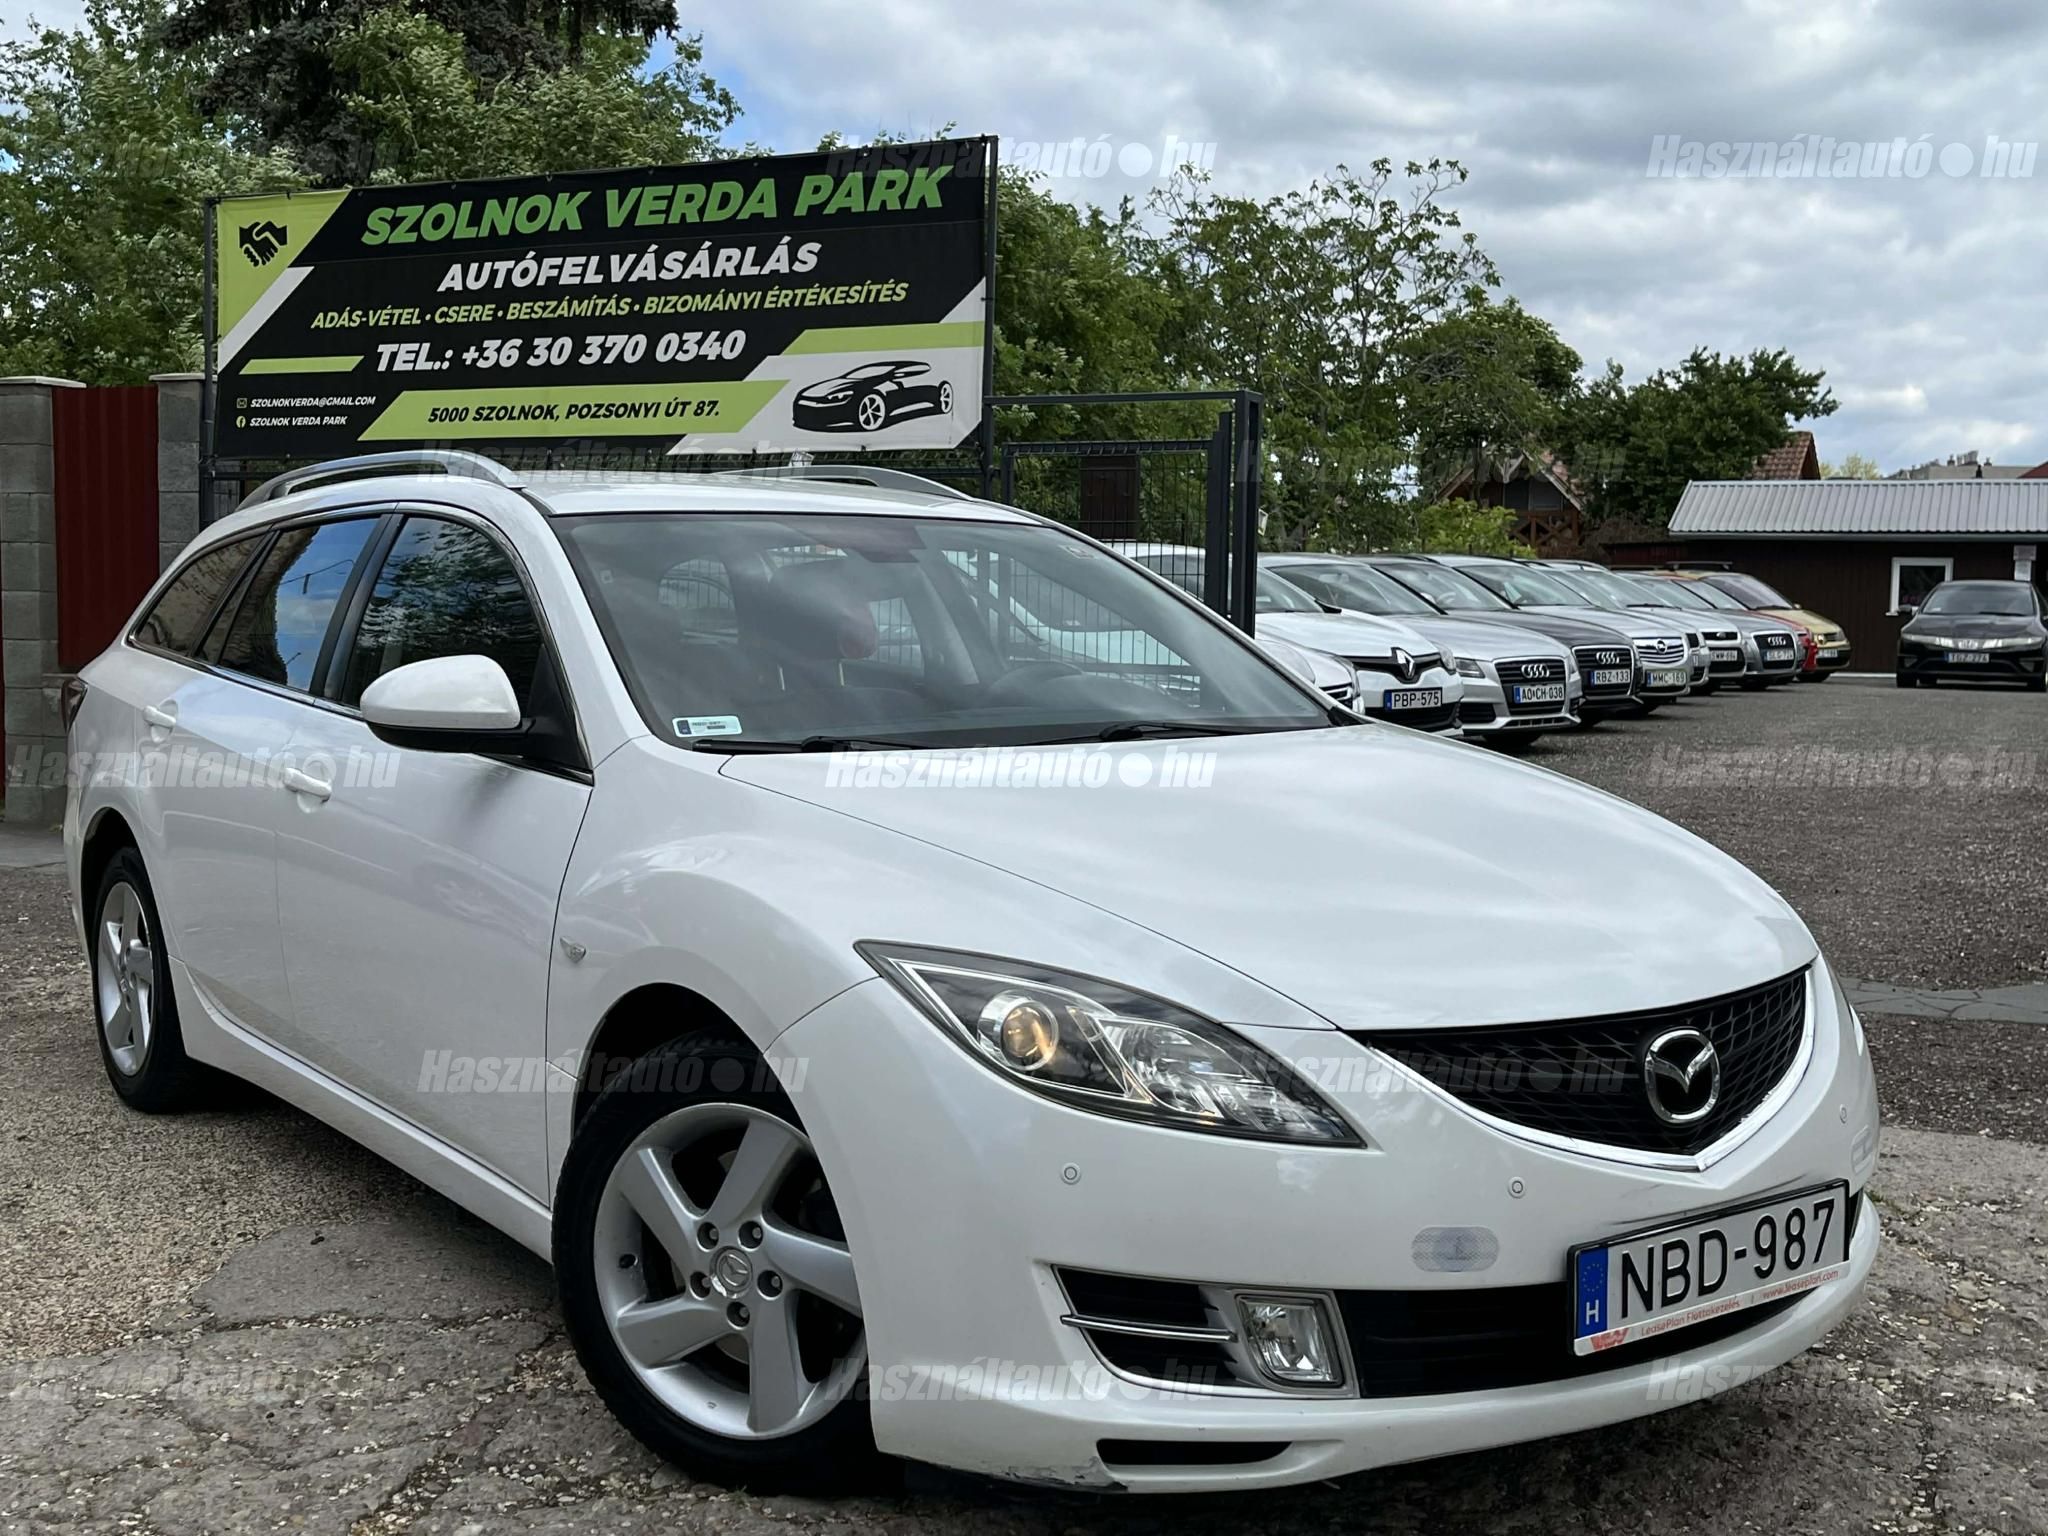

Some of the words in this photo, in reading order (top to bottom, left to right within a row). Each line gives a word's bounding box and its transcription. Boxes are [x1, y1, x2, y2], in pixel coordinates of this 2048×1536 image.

[361, 191, 592, 245] SZOLNOK
[606, 178, 777, 228] VERDA
[793, 165, 954, 217] PARK
[436, 235, 822, 293] AUTÓFELVÁSÁRLÁS
[310, 305, 421, 329] ADÁS-VÉTEL
[434, 303, 496, 324] CSERE
[506, 293, 632, 320] BESZÁMÍTÁS
[643, 287, 762, 315] BIZOMÁNYI
[763, 278, 909, 309] ÉRTÉKESÍTÉS
[376, 341, 454, 372] TEL.:
[461, 338, 523, 369] +36
[526, 335, 573, 367] 30
[578, 333, 648, 365] 370
[655, 329, 747, 363] 0340
[250, 396, 377, 408] SZOLNOKVERDA@GMAIL.COM
[427, 406, 470, 423] 5000
[472, 404, 560, 424] SZOLNOK,
[565, 401, 662, 420] POZSONYI
[664, 396, 692, 418] ÚT
[693, 399, 720, 417] 87.
[249, 416, 291, 427] SZOLNOK
[291, 416, 321, 426] VERDA
[322, 415, 348, 425] PARK
[1595, 670, 1630, 684] RBZ-133
[1393, 690, 1440, 707] PBP-575
[1621, 1198, 1835, 1318] NBD-987
